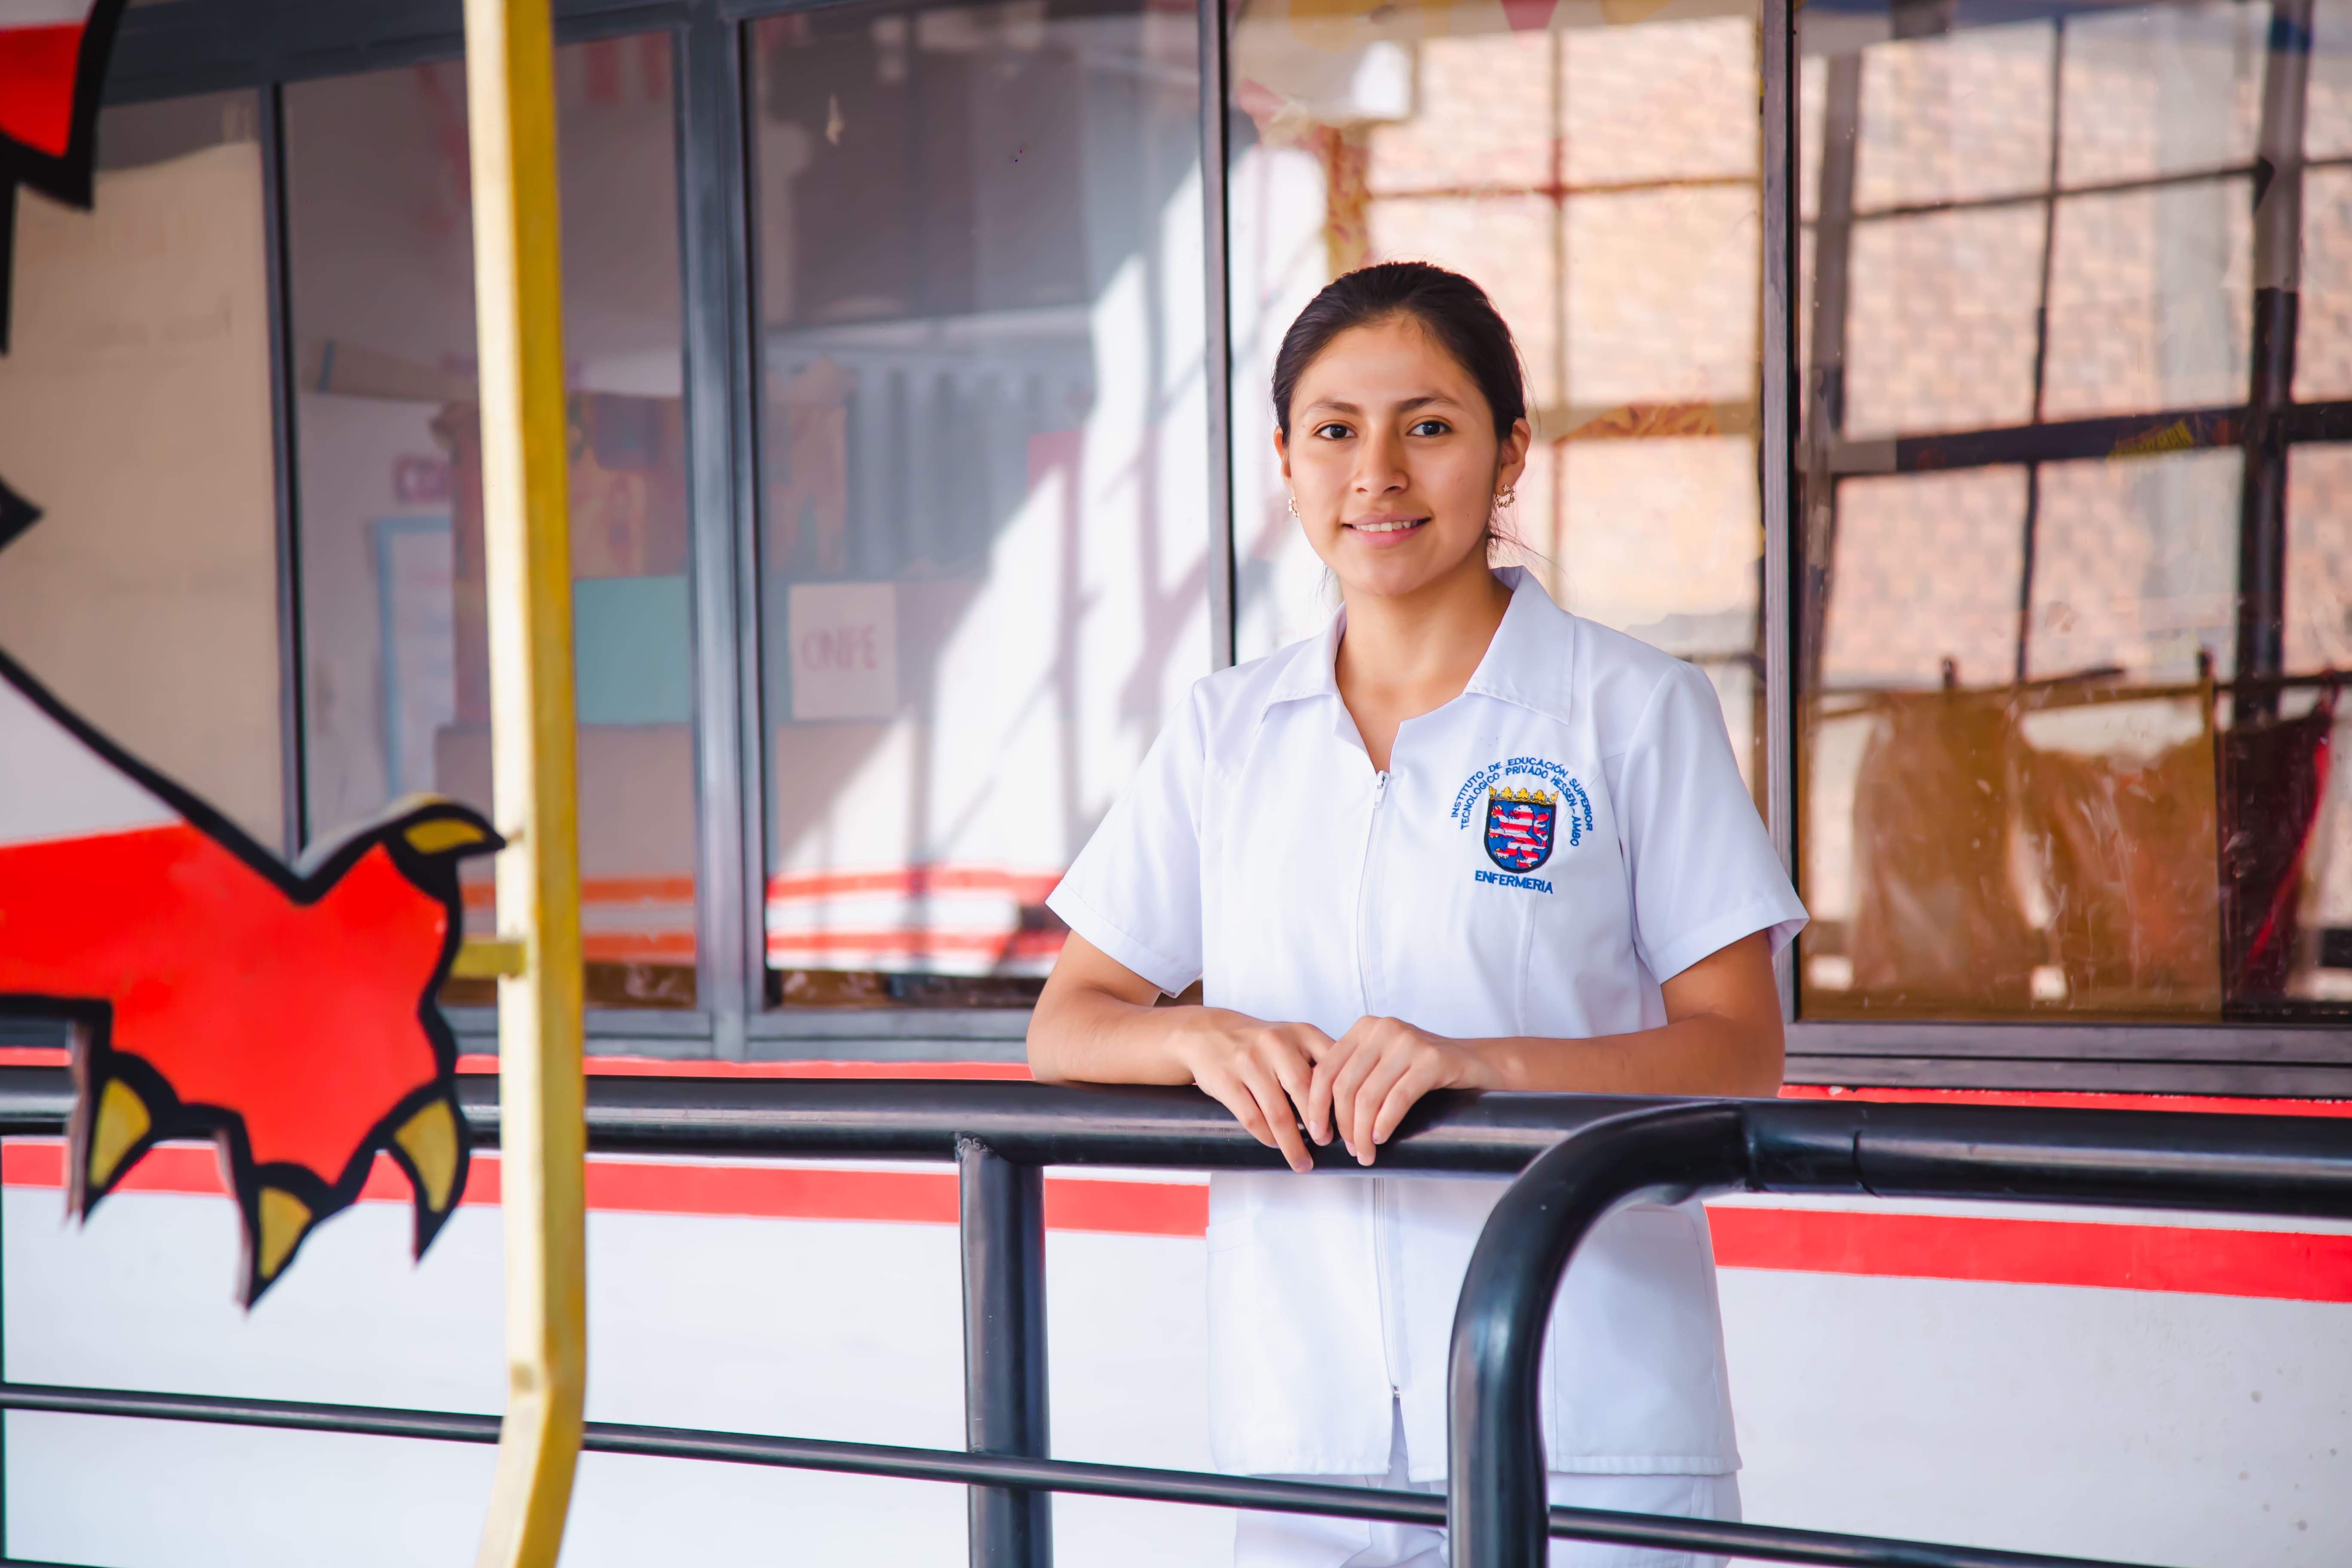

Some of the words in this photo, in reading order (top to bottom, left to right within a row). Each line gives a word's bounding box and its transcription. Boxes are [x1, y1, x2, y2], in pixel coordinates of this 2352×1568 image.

[1451, 771, 1484, 817] INSTITUTO
[1488, 762, 1502, 772] DE
[1508, 757, 1568, 778] EDUCACIÓN
[1569, 778, 1592, 831] SUPERIOR
[1461, 772, 1500, 830] TECNOLOGICO
[1506, 765, 1548, 779] PRIVADO
[1475, 870, 1553, 894] ENFERMERIA
